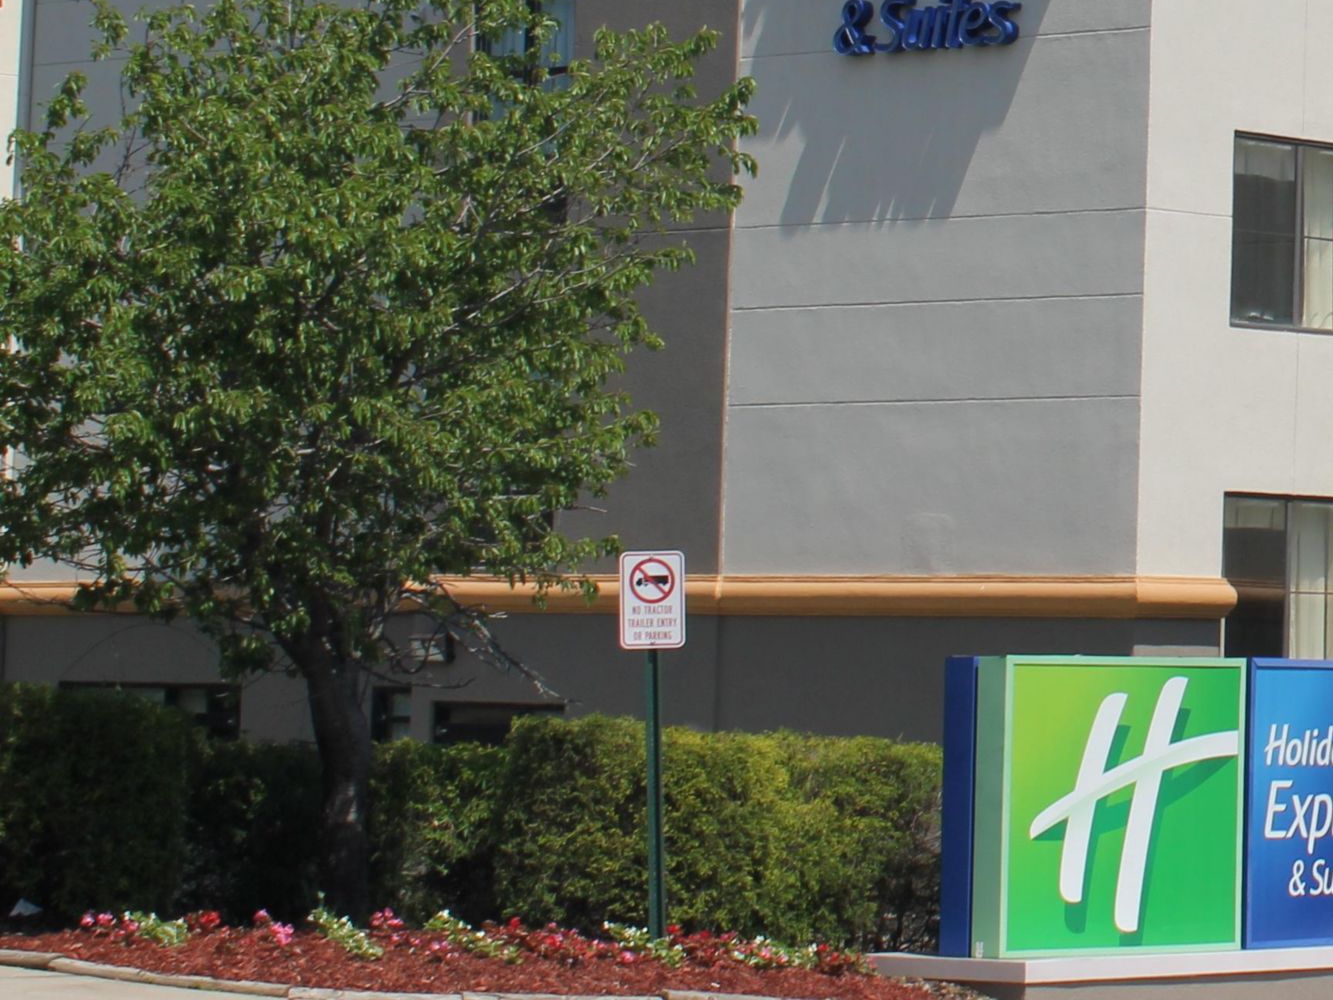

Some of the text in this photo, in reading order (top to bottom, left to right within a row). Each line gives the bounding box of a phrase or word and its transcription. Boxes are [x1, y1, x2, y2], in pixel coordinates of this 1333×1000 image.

[632, 605, 673, 615] NO TRACTOR
[628, 618, 677, 628] TRAILER ENTRY
[633, 631, 672, 641] OR PARKING
[1288, 859, 1306, 896] &
